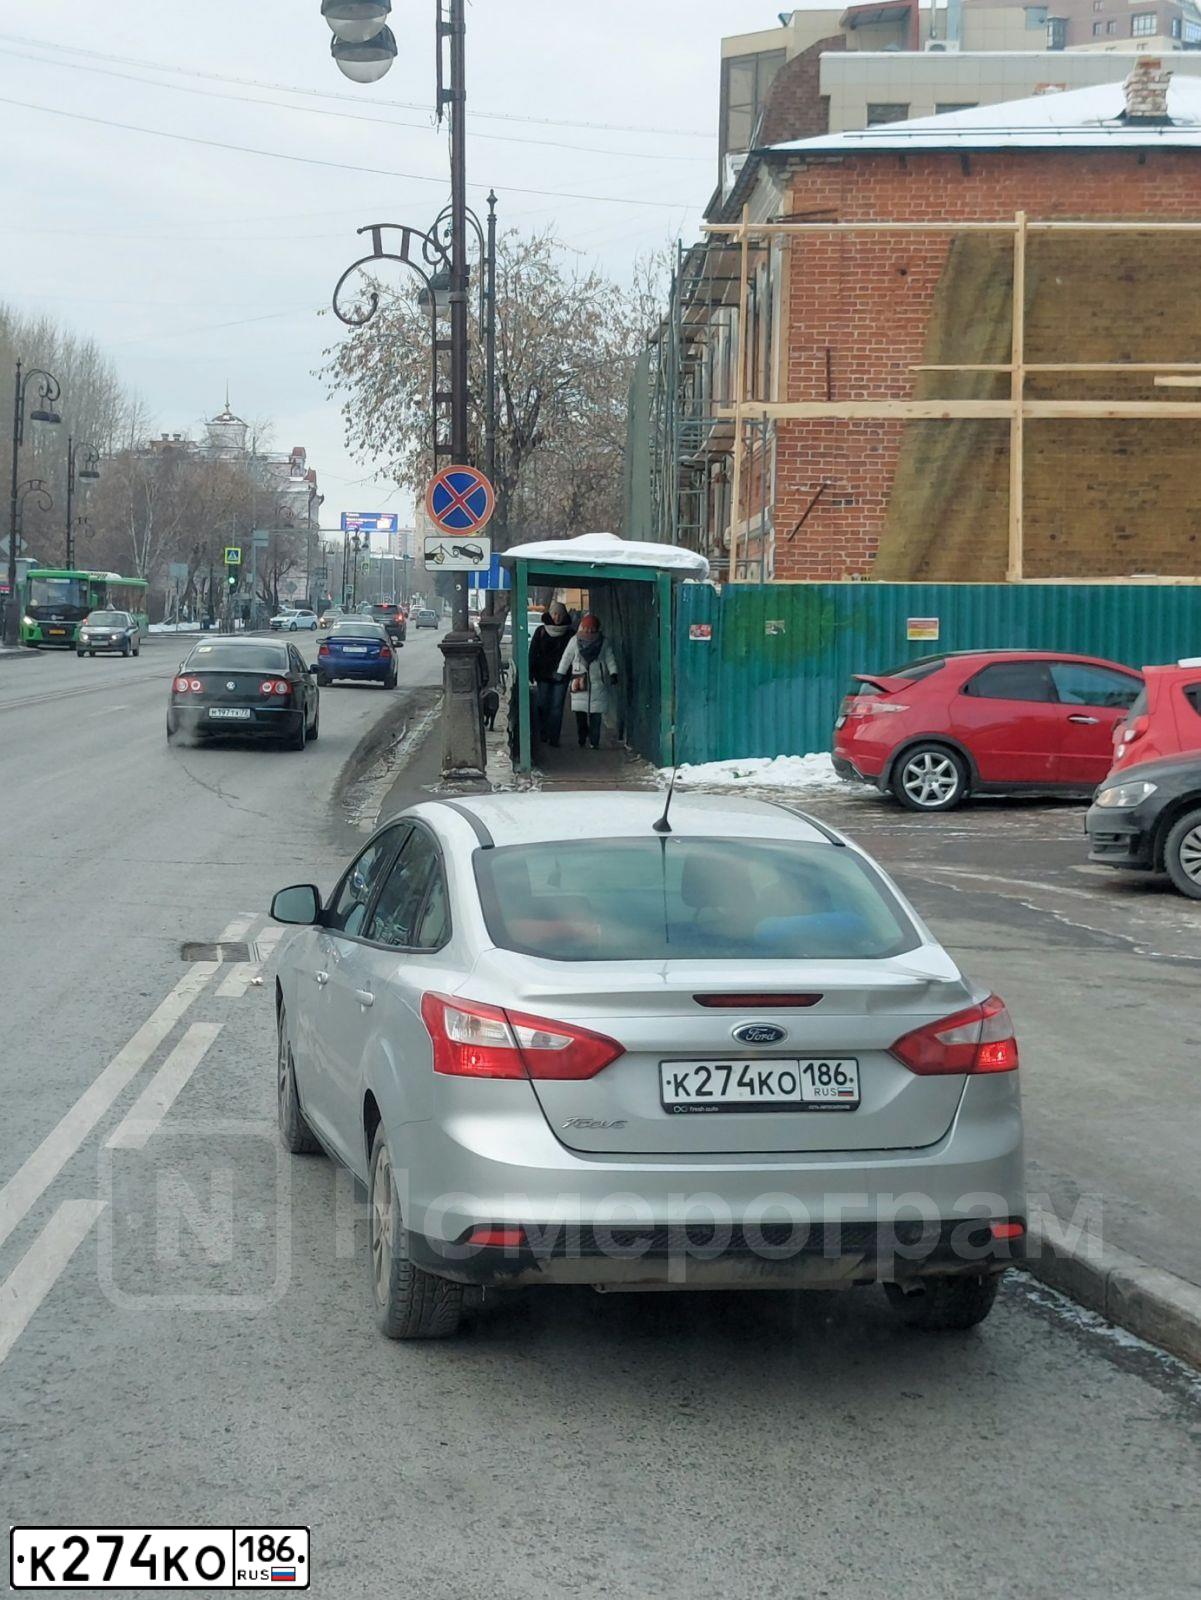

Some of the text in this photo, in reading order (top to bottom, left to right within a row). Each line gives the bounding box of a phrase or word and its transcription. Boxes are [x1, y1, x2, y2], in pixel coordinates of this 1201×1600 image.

[745, 1027, 776, 1041] Ford
[673, 1062, 848, 1098] К274КО 186
[814, 1087, 838, 1097] RUS
